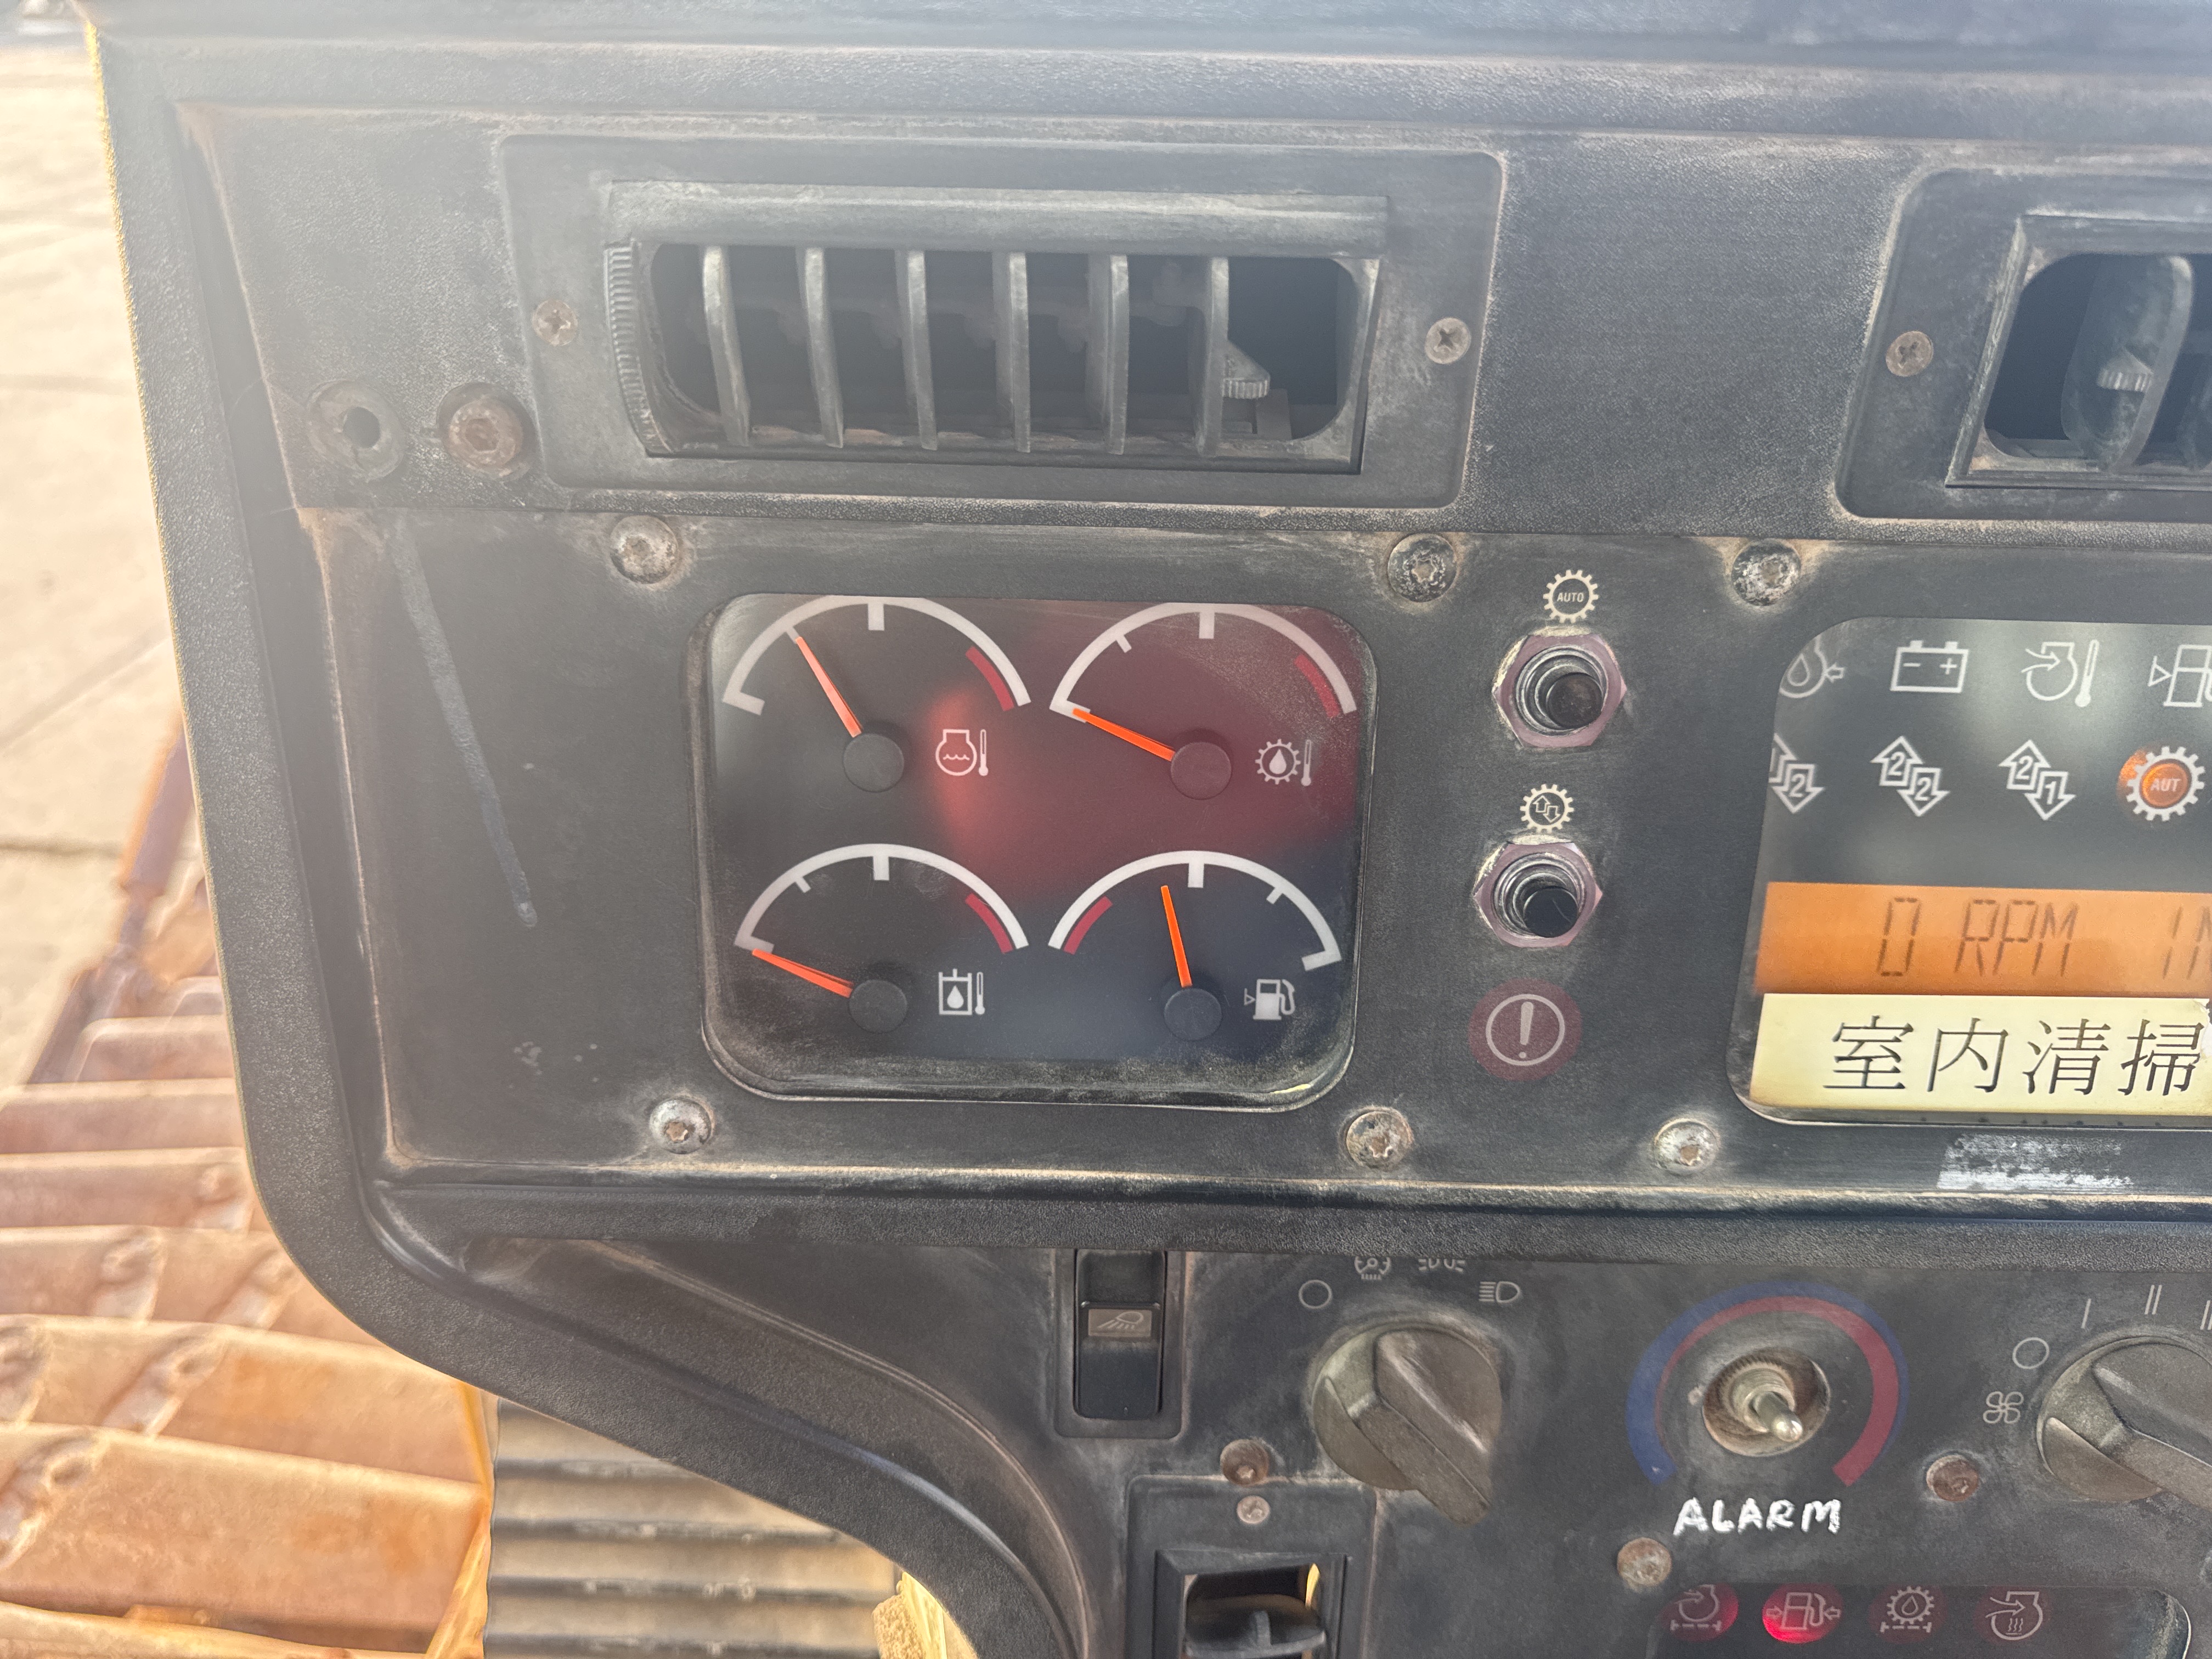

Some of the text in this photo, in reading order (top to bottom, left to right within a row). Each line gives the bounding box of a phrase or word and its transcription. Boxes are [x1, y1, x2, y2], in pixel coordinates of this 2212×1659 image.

[1557, 591, 1584, 602] AUTO
[1889, 751, 1906, 776] 2
[2015, 756, 2034, 780] 2
[1790, 774, 1805, 798] 2
[1914, 776, 1932, 802] 2
[2045, 781, 2057, 805] 1
[1953, 898, 2080, 978] RPM
[1822, 1014, 2204, 1096] 室内清掃
[1673, 1497, 1842, 1536] ALARM
